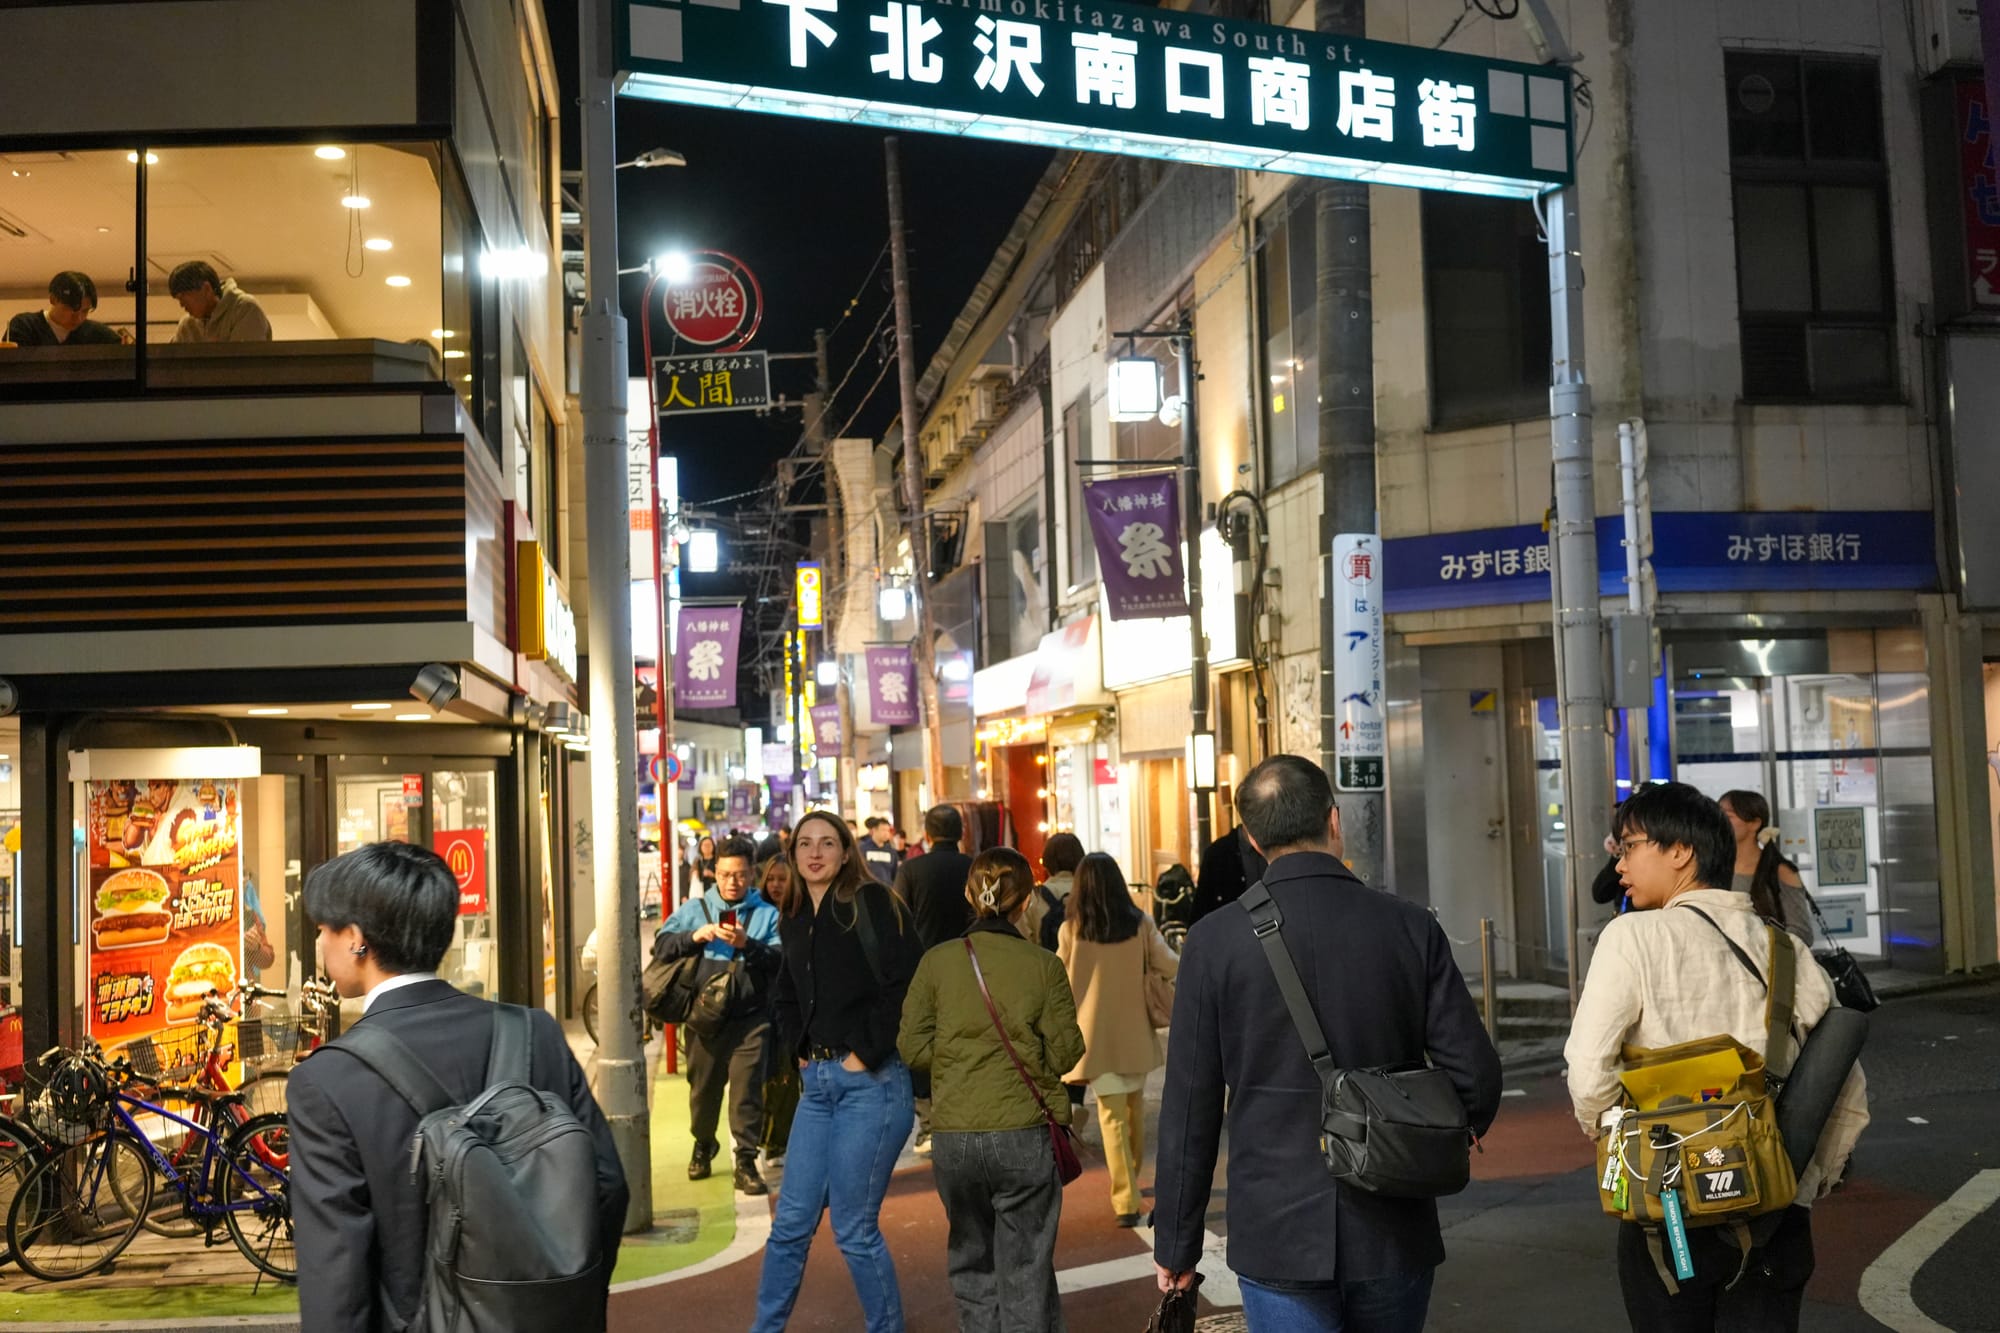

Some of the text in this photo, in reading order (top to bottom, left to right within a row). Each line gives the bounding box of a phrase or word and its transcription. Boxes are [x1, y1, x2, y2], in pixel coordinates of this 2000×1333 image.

[1213, 24, 1306, 57] South
[1326, 42, 1366, 65] st.
[761, 0, 1477, 152] 下北沢南口商店街
[672, 287, 739, 320] 消火栓
[662, 370, 734, 408] 人間
[734, 396, 766, 405] レストラン
[1103, 492, 1168, 513] 八幡神社
[1118, 521, 1173, 580] 祭
[1727, 533, 1862, 562] みずほ銀行
[687, 640, 724, 681] 祭
[879, 672, 908, 704] 祭
[1351, 774, 1377, 785] 2-19
[1705, 1189, 1741, 1200] MILLENNIUM
[1668, 1200, 1688, 1272] REMOVE BEFORE FLIGHT
